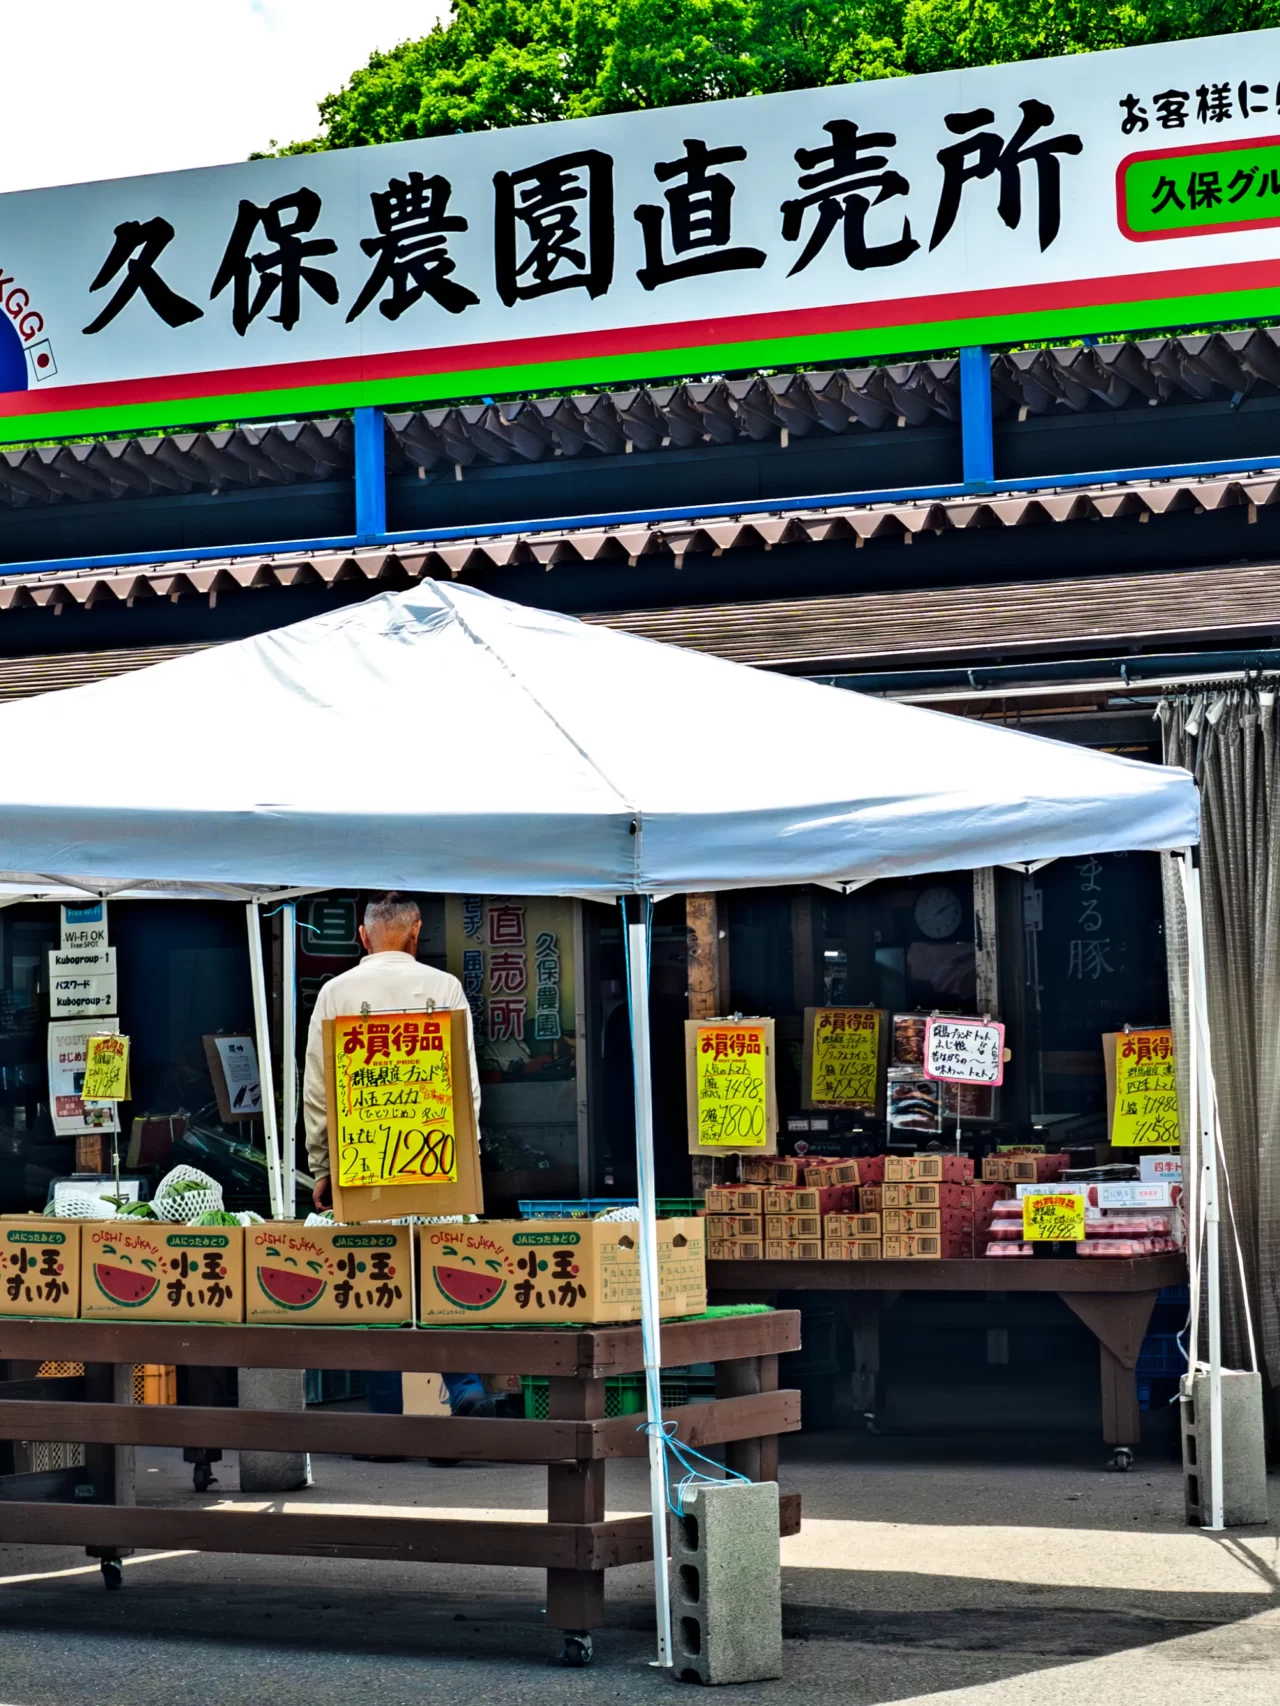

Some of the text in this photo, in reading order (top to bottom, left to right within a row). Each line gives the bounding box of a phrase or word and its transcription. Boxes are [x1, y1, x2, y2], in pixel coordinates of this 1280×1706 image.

[1118, 79, 1280, 135] お客様に
[82, 98, 1084, 337] 久保農園直売所
[65, 930, 105, 942] Wi-Fi OK
[486, 902, 528, 1041] 直売所
[534, 930, 562, 1041] 久保農園
[820, 1012, 876, 1035] お買得品
[343, 1022, 444, 1065] お買得品
[701, 1033, 761, 1062] お買得品
[1122, 1037, 1173, 1065] お買得
[353, 1090, 379, 1107] 小玉
[382, 1088, 420, 1106] スイカ
[725, 1077, 764, 1100] ¥498
[718, 1104, 765, 1138] ¥800
[10, 1233, 63, 1242] JAにったみどり
[92, 1230, 123, 1243] OISHI
[170, 1238, 225, 1246] JAにったみどり
[255, 1232, 287, 1246] OISHI
[336, 1238, 393, 1246] JAにったみどり
[430, 1231, 464, 1245] OISHI
[516, 1236, 577, 1244] JAにったみどり
[10, 1247, 64, 1276] 小玉
[170, 1251, 227, 1280] 小玉
[337, 1252, 396, 1280] 小玉
[517, 1250, 580, 1279] 小玉
[7, 1274, 69, 1303] すいか
[166, 1279, 233, 1308] すいか
[333, 1280, 403, 1309] すいか
[513, 1279, 587, 1309] すいか
